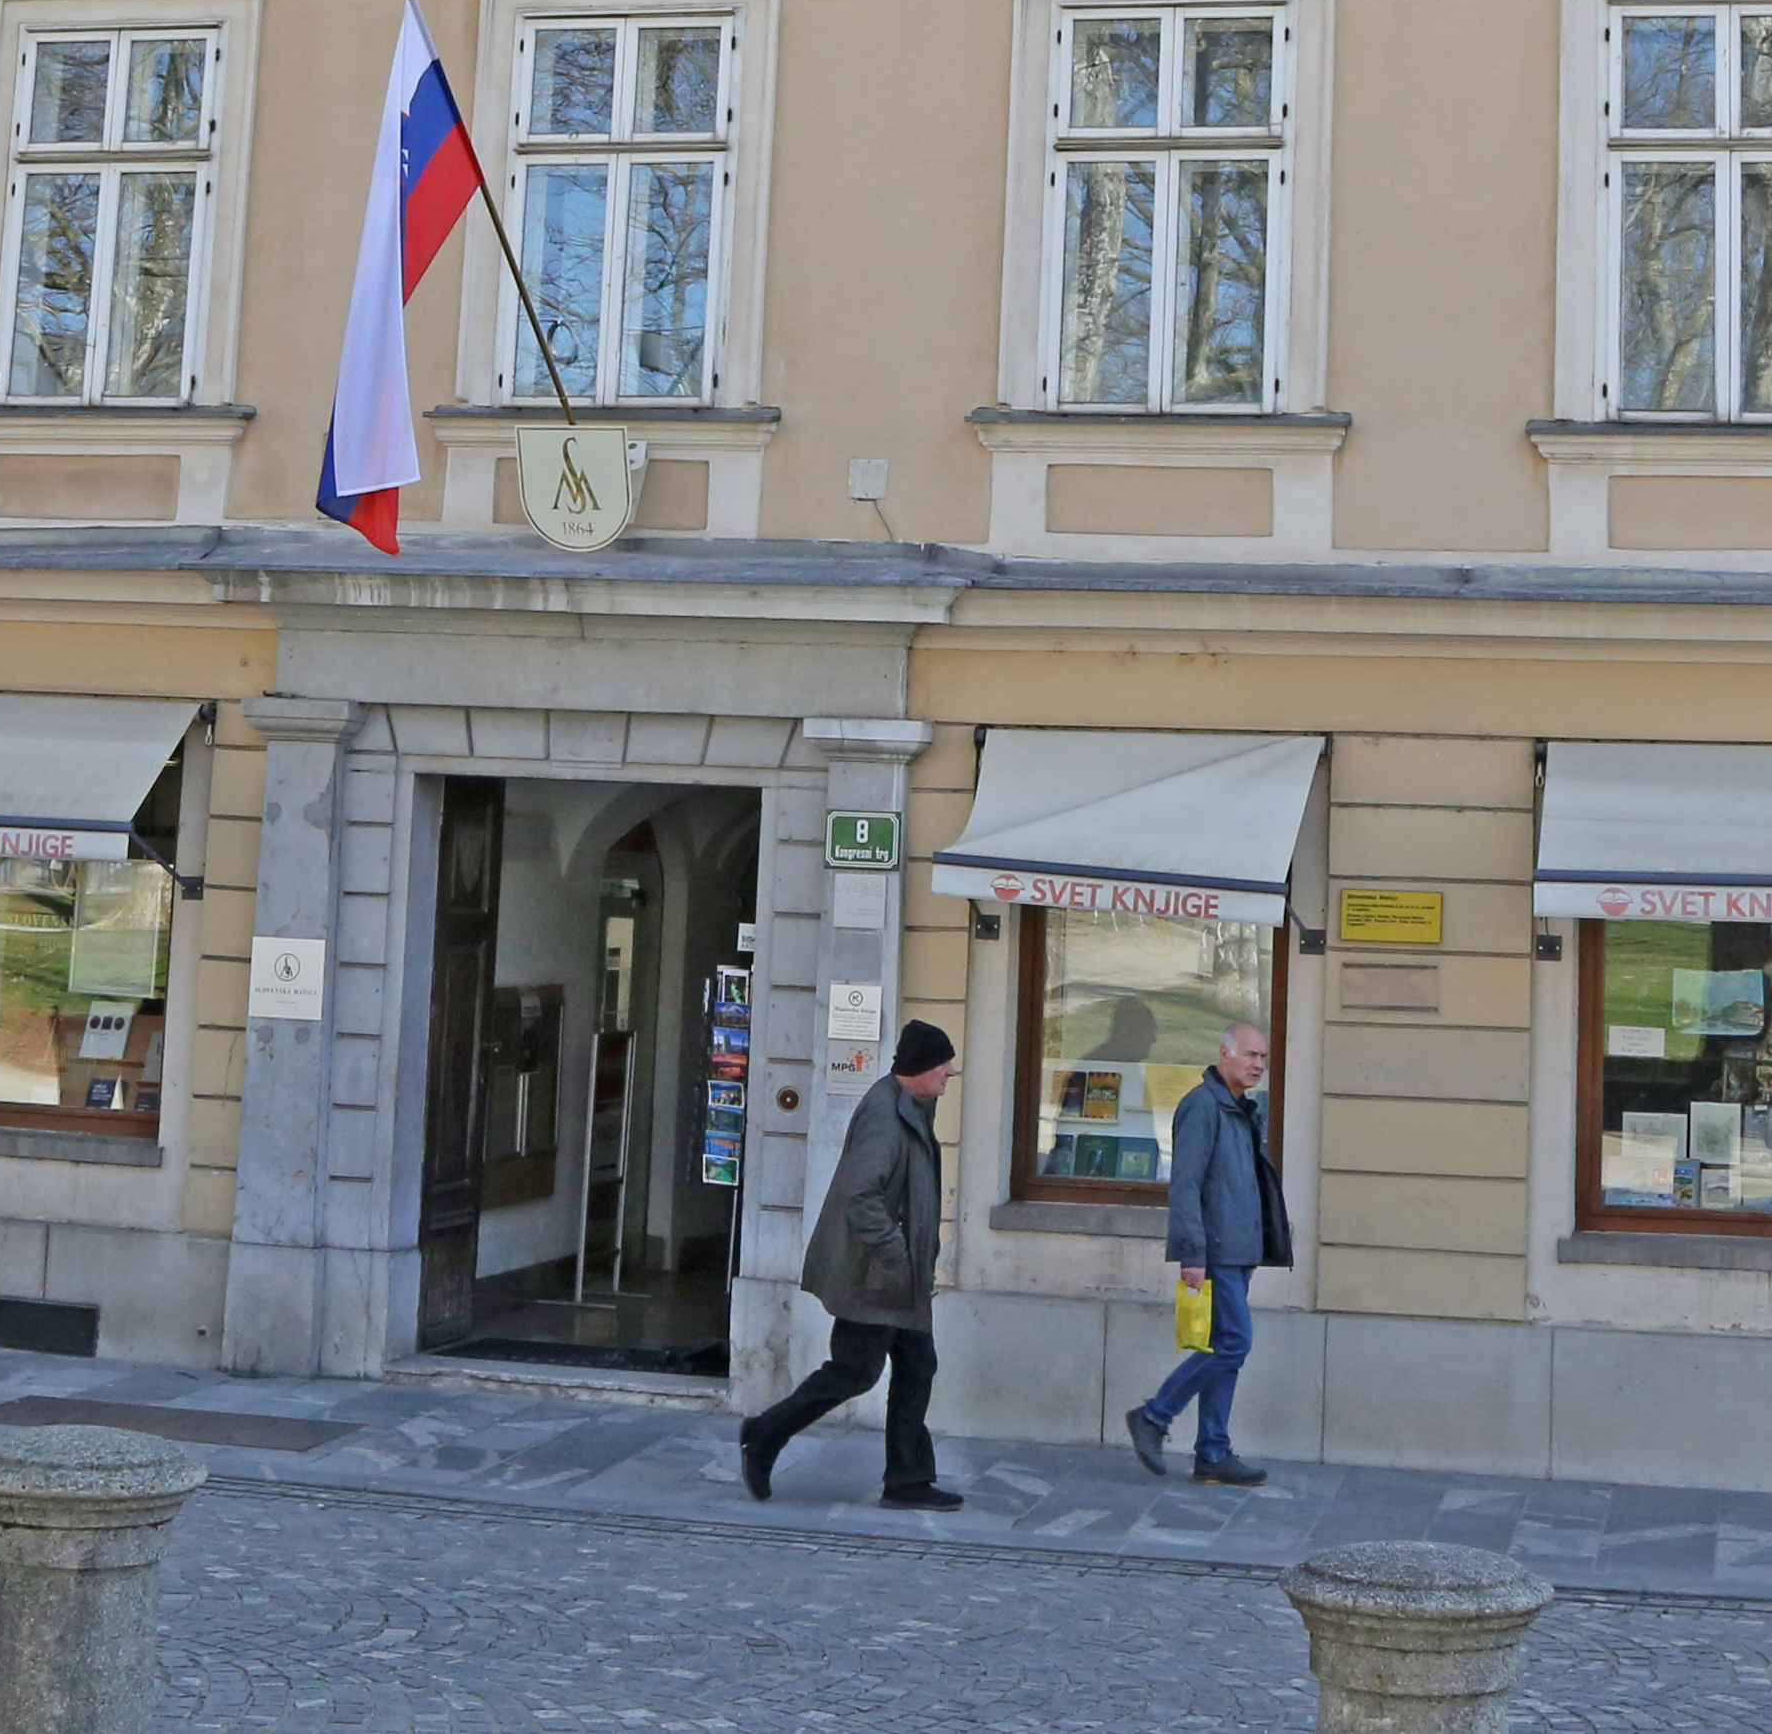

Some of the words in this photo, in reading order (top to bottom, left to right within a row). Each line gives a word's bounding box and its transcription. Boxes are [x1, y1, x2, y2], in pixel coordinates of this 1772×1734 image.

[562, 521, 595, 536] 1864
[855, 818, 871, 834] 8
[834, 844, 873, 861] Kongresni
[875, 846, 889, 862] trg
[1029, 877, 1104, 908] SVET
[1110, 885, 1220, 919] KNJIGE
[1639, 889, 1717, 917] SVET
[831, 1062, 857, 1073] MPG
